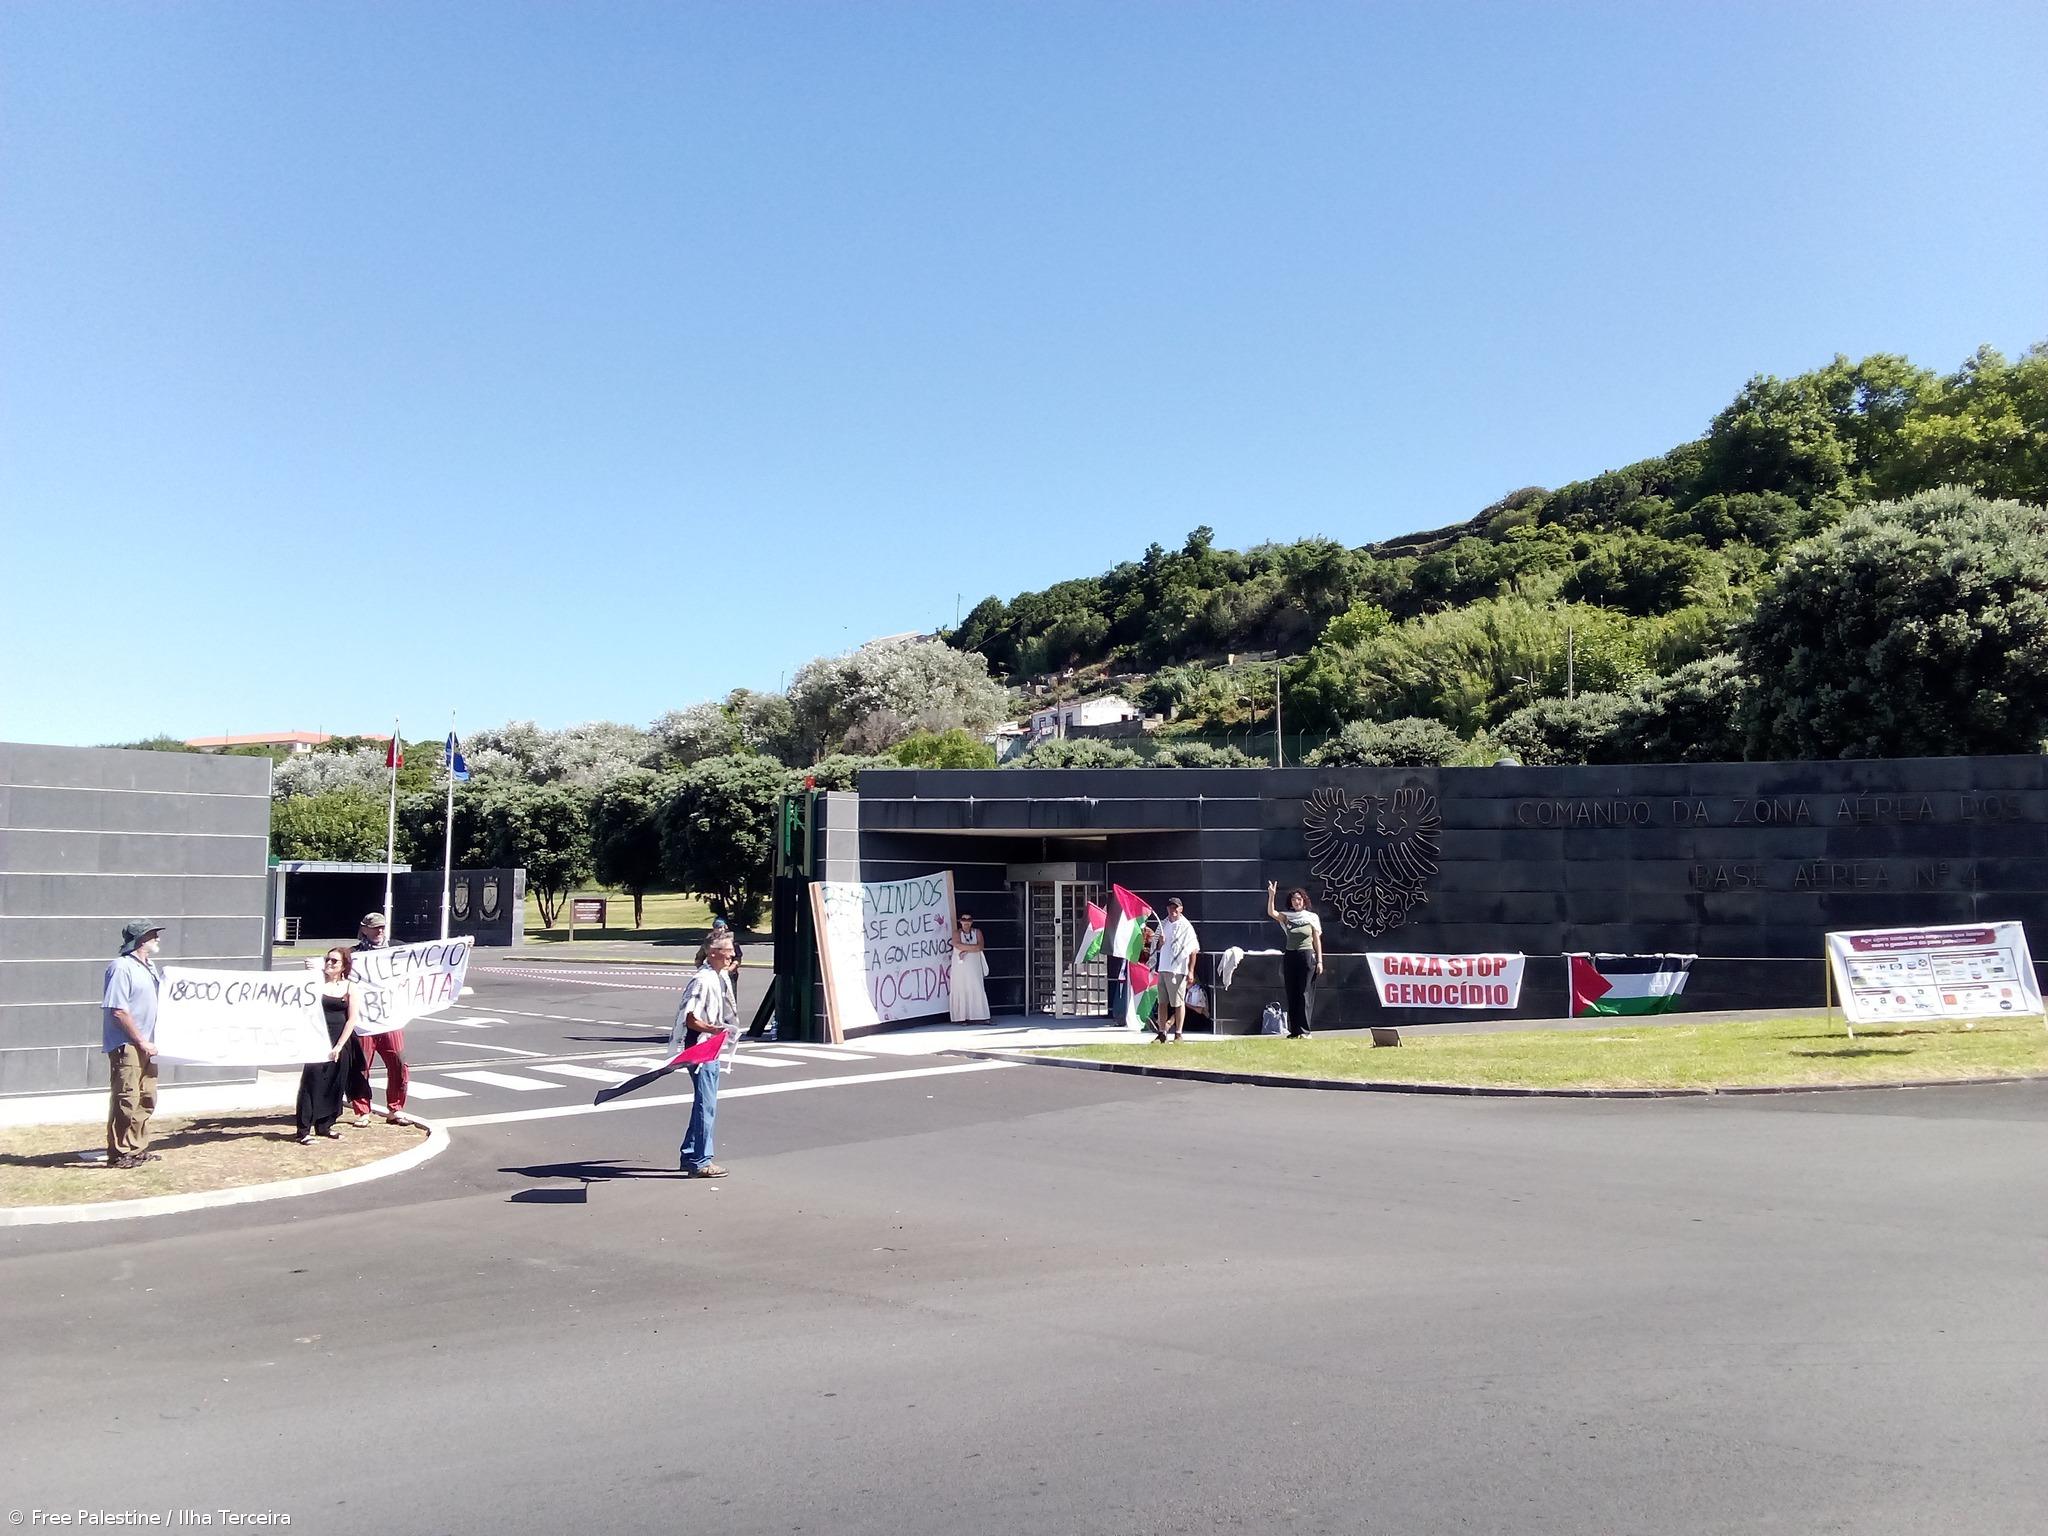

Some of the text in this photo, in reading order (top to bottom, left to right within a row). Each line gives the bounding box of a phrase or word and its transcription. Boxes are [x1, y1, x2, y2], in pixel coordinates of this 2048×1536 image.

[1518, 790, 2024, 825] COMANDO DA ZONA AÉREA DOS
[1694, 864, 1768, 889] BASE
[1794, 857, 1889, 888] AÉREA
[895, 913, 934, 938] QUE
[884, 938, 954, 965] GOVERNOS
[1383, 956, 1508, 978] GAZA STOP
[224, 980, 317, 1009] CRIANÇAS
[398, 972, 452, 1006] MATA
[1384, 981, 1509, 1006] GENOCÍDIO
